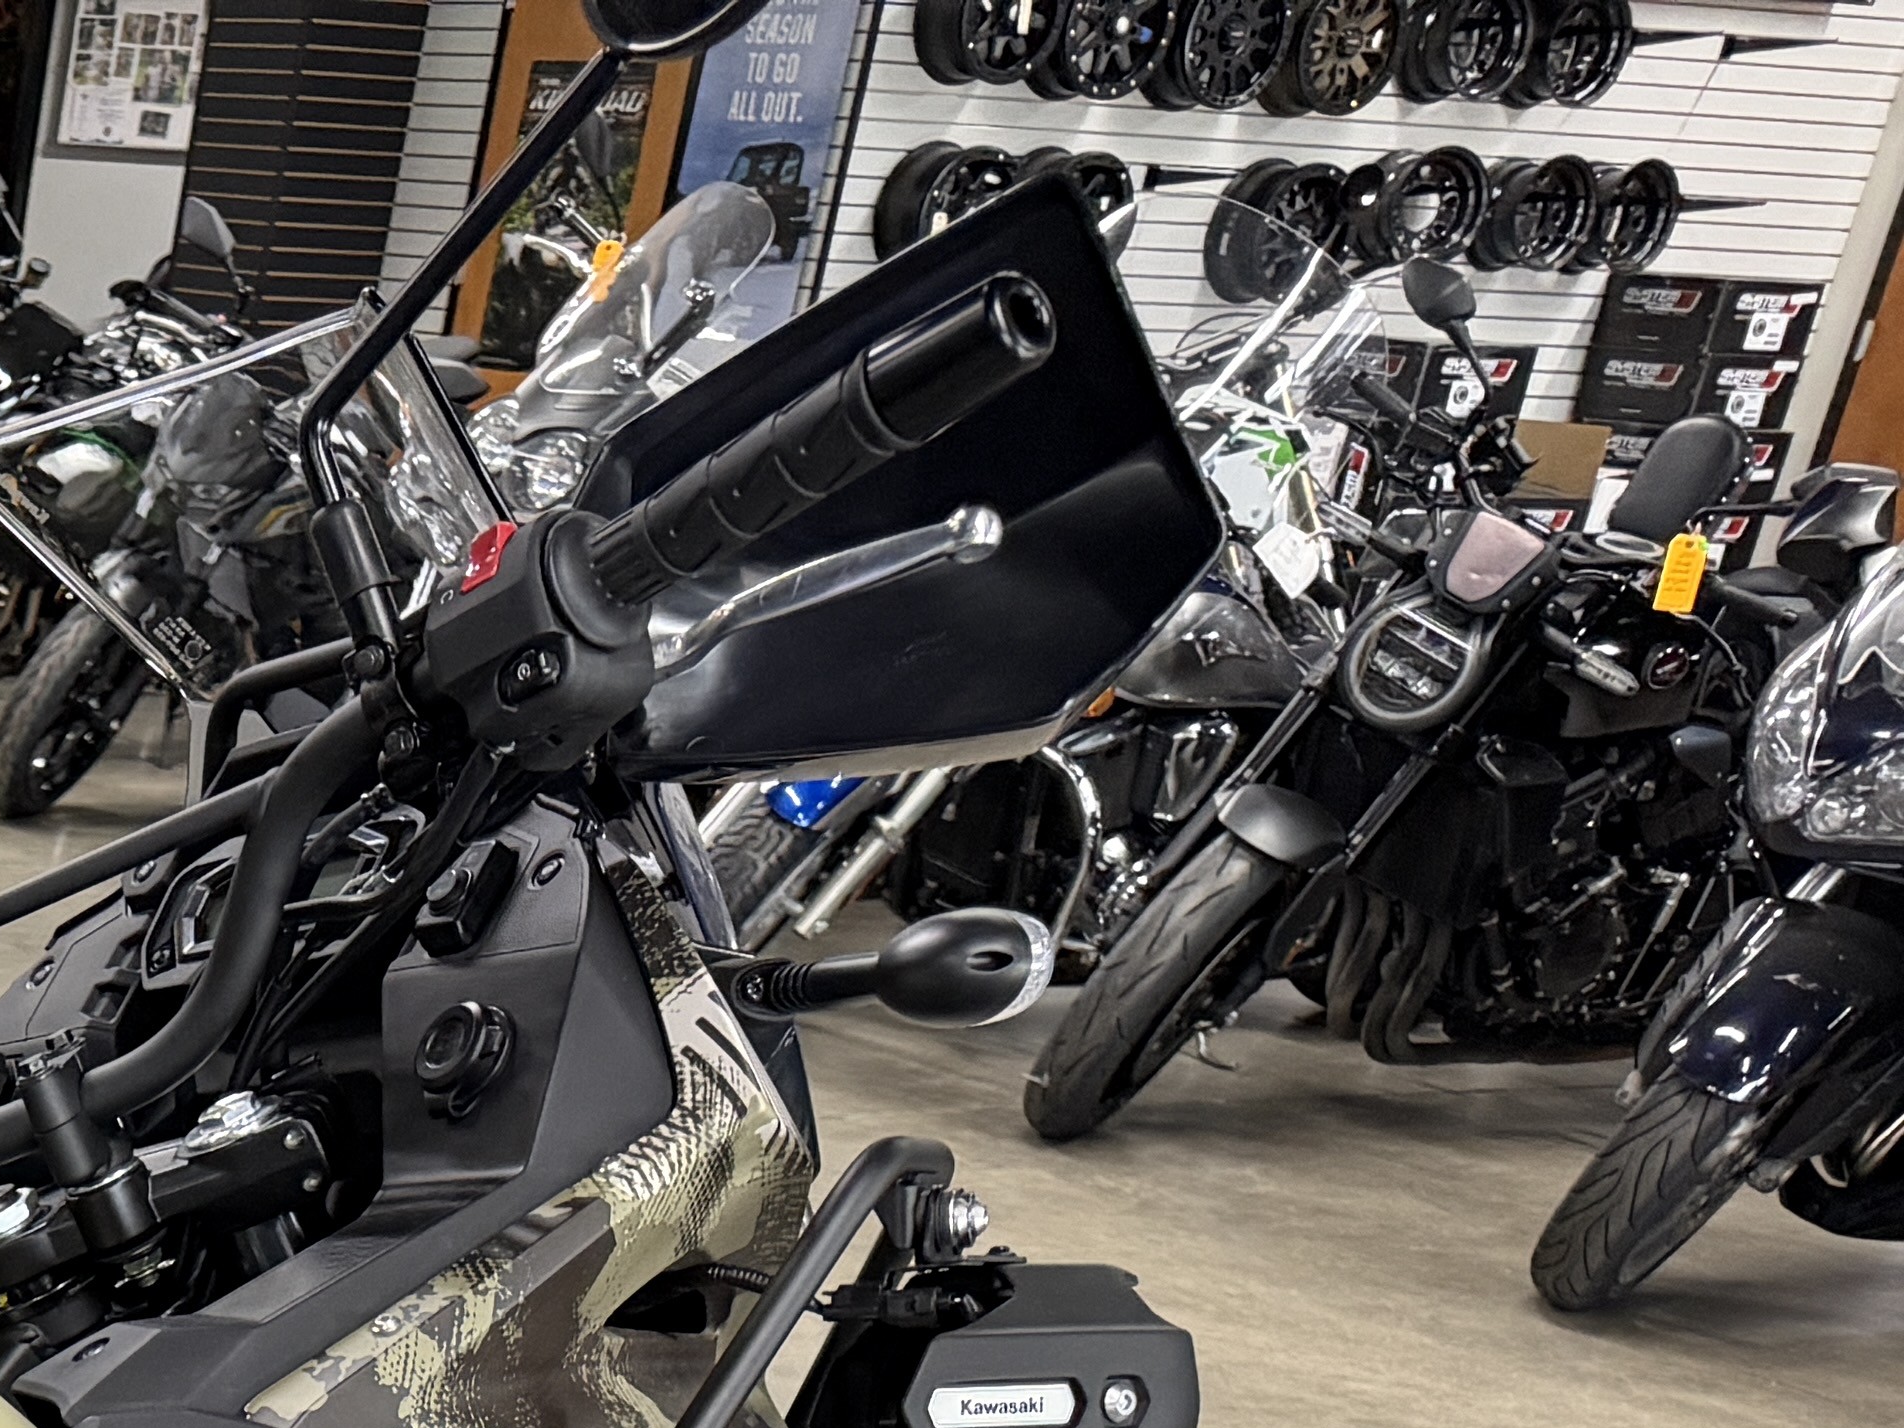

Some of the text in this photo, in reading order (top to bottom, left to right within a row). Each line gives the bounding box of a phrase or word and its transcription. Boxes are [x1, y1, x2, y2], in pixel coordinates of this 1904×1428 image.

[745, 13, 817, 44] SEASON
[747, 52, 800, 83] TO GO
[728, 90, 756, 122] ALL
[959, 1396, 1045, 1416] Kawasaki
